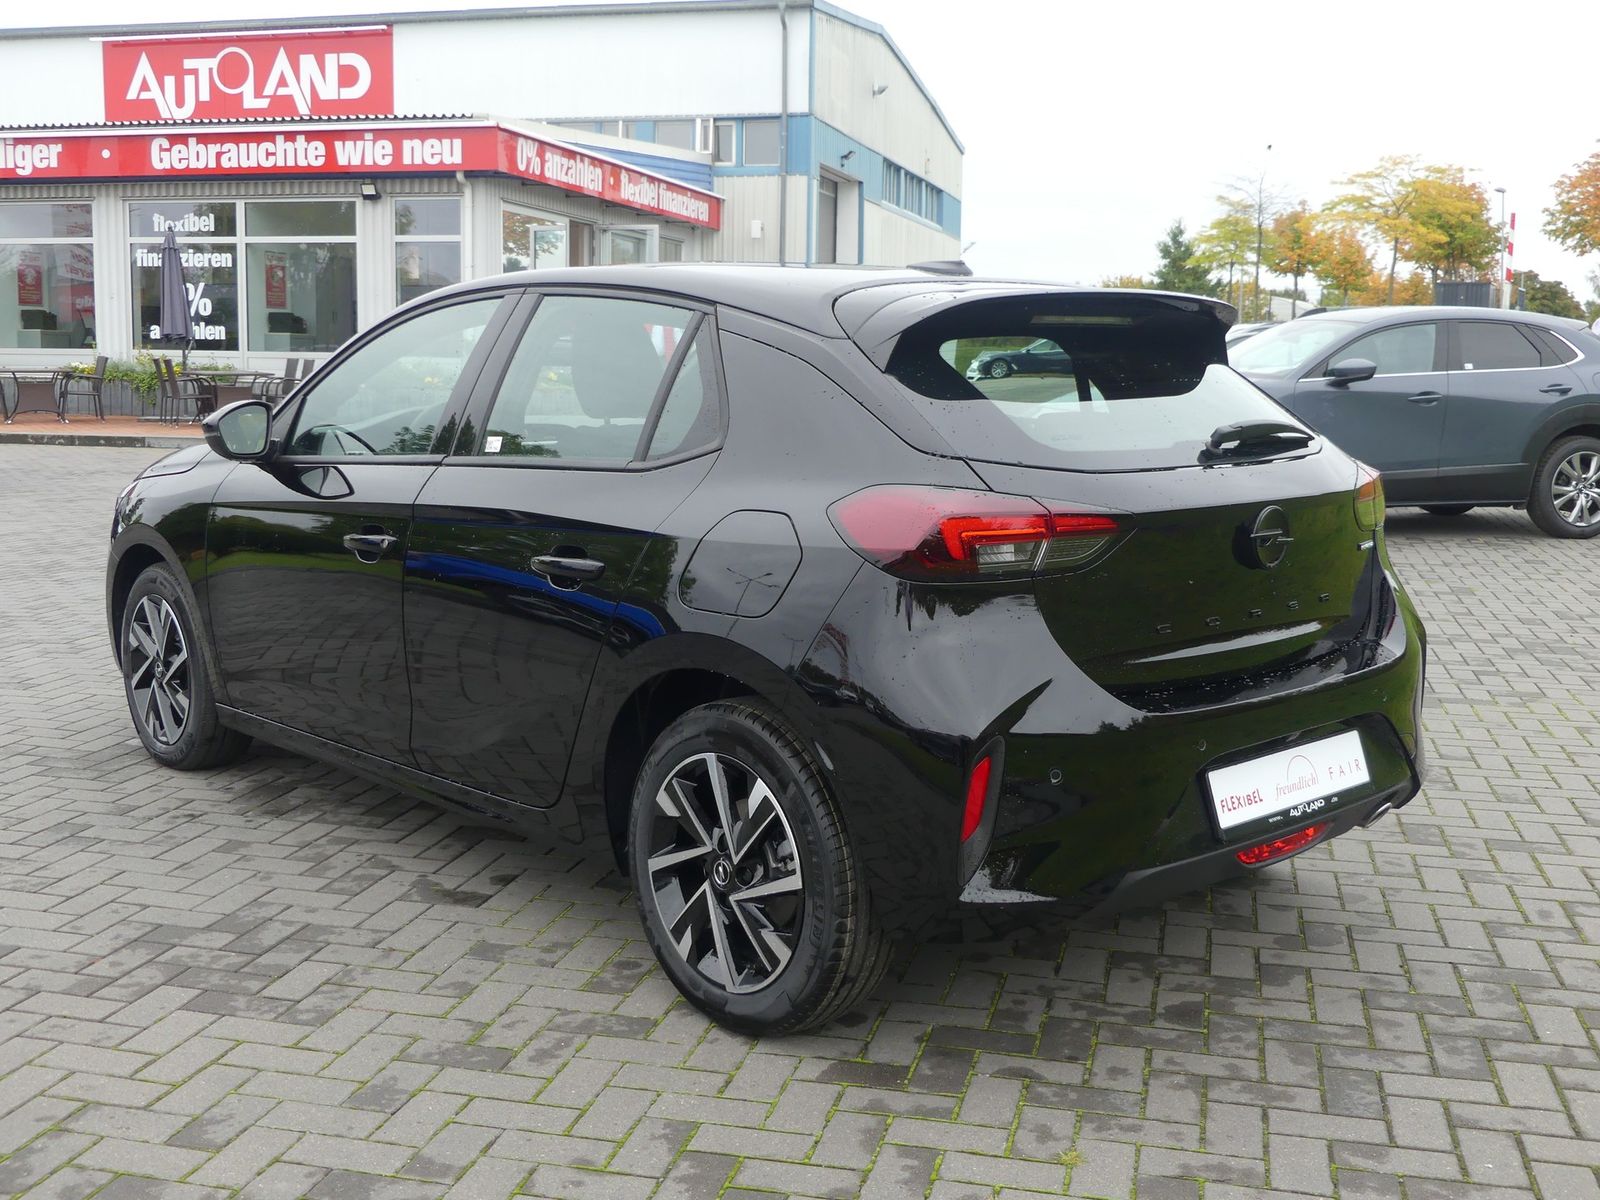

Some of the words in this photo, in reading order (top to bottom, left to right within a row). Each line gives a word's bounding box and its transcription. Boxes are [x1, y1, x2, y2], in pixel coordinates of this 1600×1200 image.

[126, 46, 372, 119] AUTOLAND
[151, 135, 326, 169] Gebrauchte
[334, 132, 393, 166] wie
[403, 138, 462, 165] neu
[517, 137, 541, 176] 0%
[544, 152, 602, 192] anzahlen
[620, 169, 659, 208] flexibel
[659, 182, 709, 222] finanzieren
[136, 249, 232, 267] finzieren
[150, 322, 226, 340] ahlen
[1220, 788, 1263, 814] FLEXIBEL
[1275, 773, 1319, 800] freundlich
[1328, 759, 1362, 780] FAIR
[1290, 799, 1325, 816] AUTOLAND
